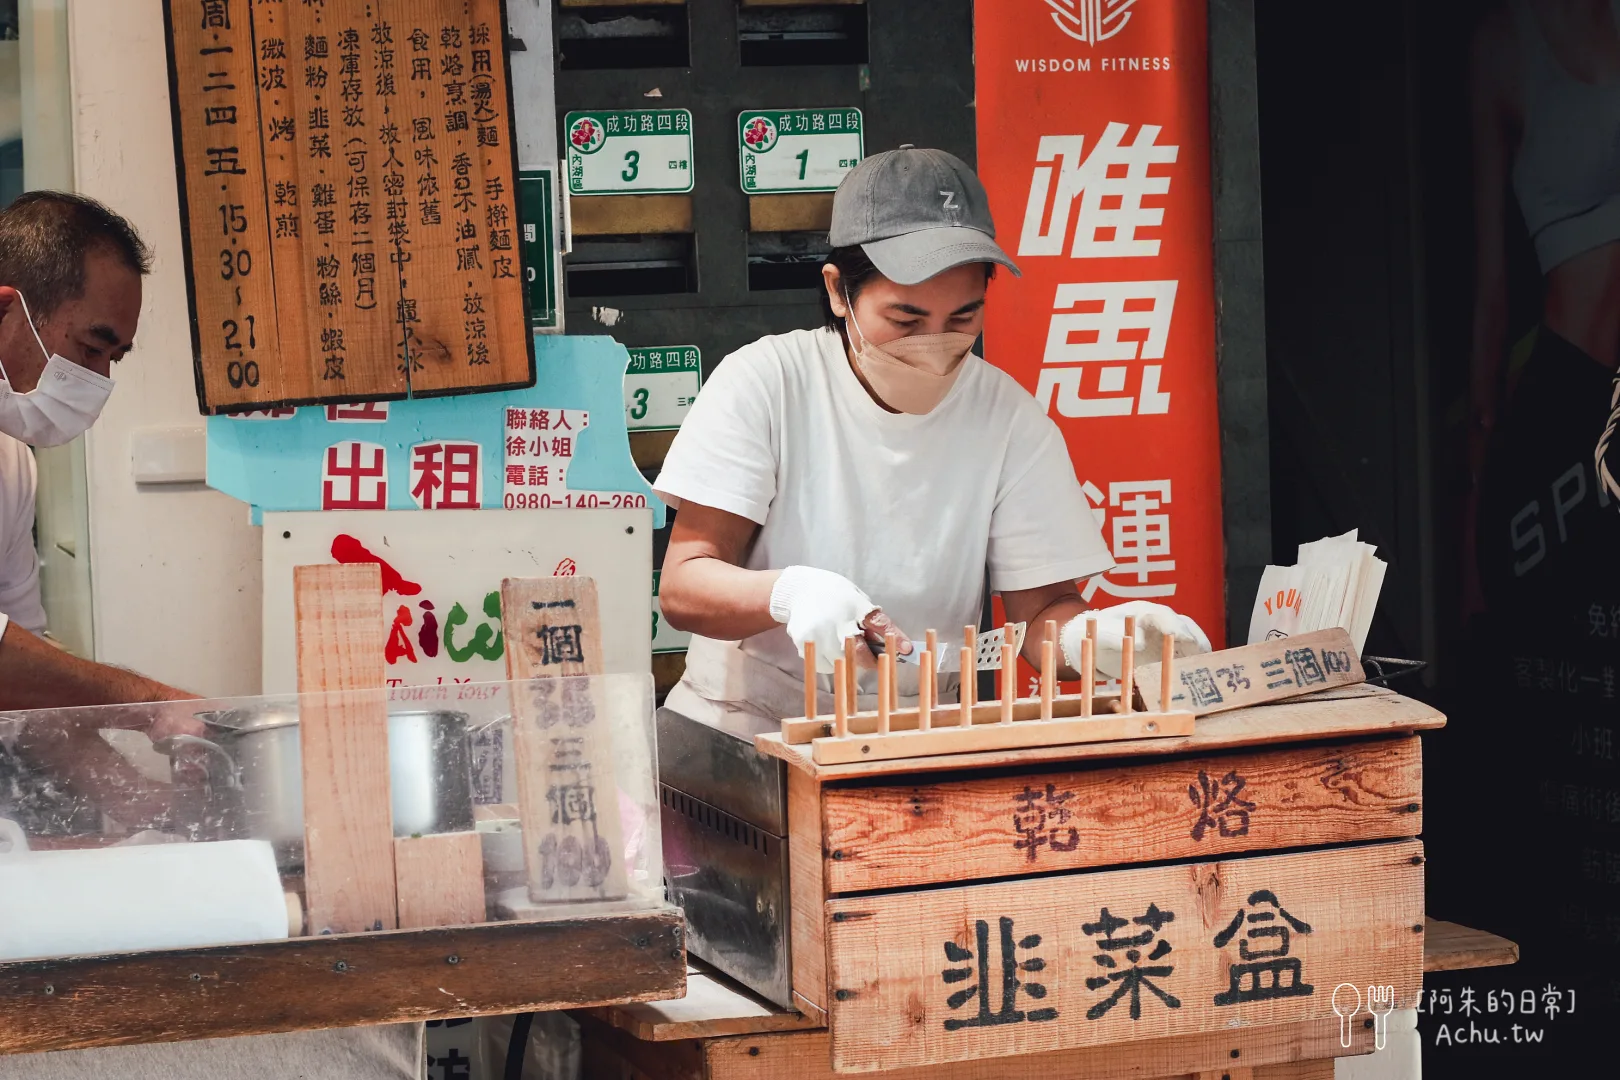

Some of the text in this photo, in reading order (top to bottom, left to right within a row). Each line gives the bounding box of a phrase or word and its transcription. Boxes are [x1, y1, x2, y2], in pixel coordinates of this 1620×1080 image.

[1015, 57, 1171, 72] WISDOM FITNESS
[606, 114, 689, 133] 成功路四段
[779, 112, 859, 131] 成功路四段
[622, 150, 640, 182] 3
[795, 148, 809, 180] 1
[940, 190, 959, 209] Z
[630, 388, 650, 420] 3
[506, 436, 572, 457] 徐小姐
[323, 442, 481, 510] 出租
[504, 493, 646, 510] 0980-140-260
[941, 889, 1315, 1032] 韭菜盒
